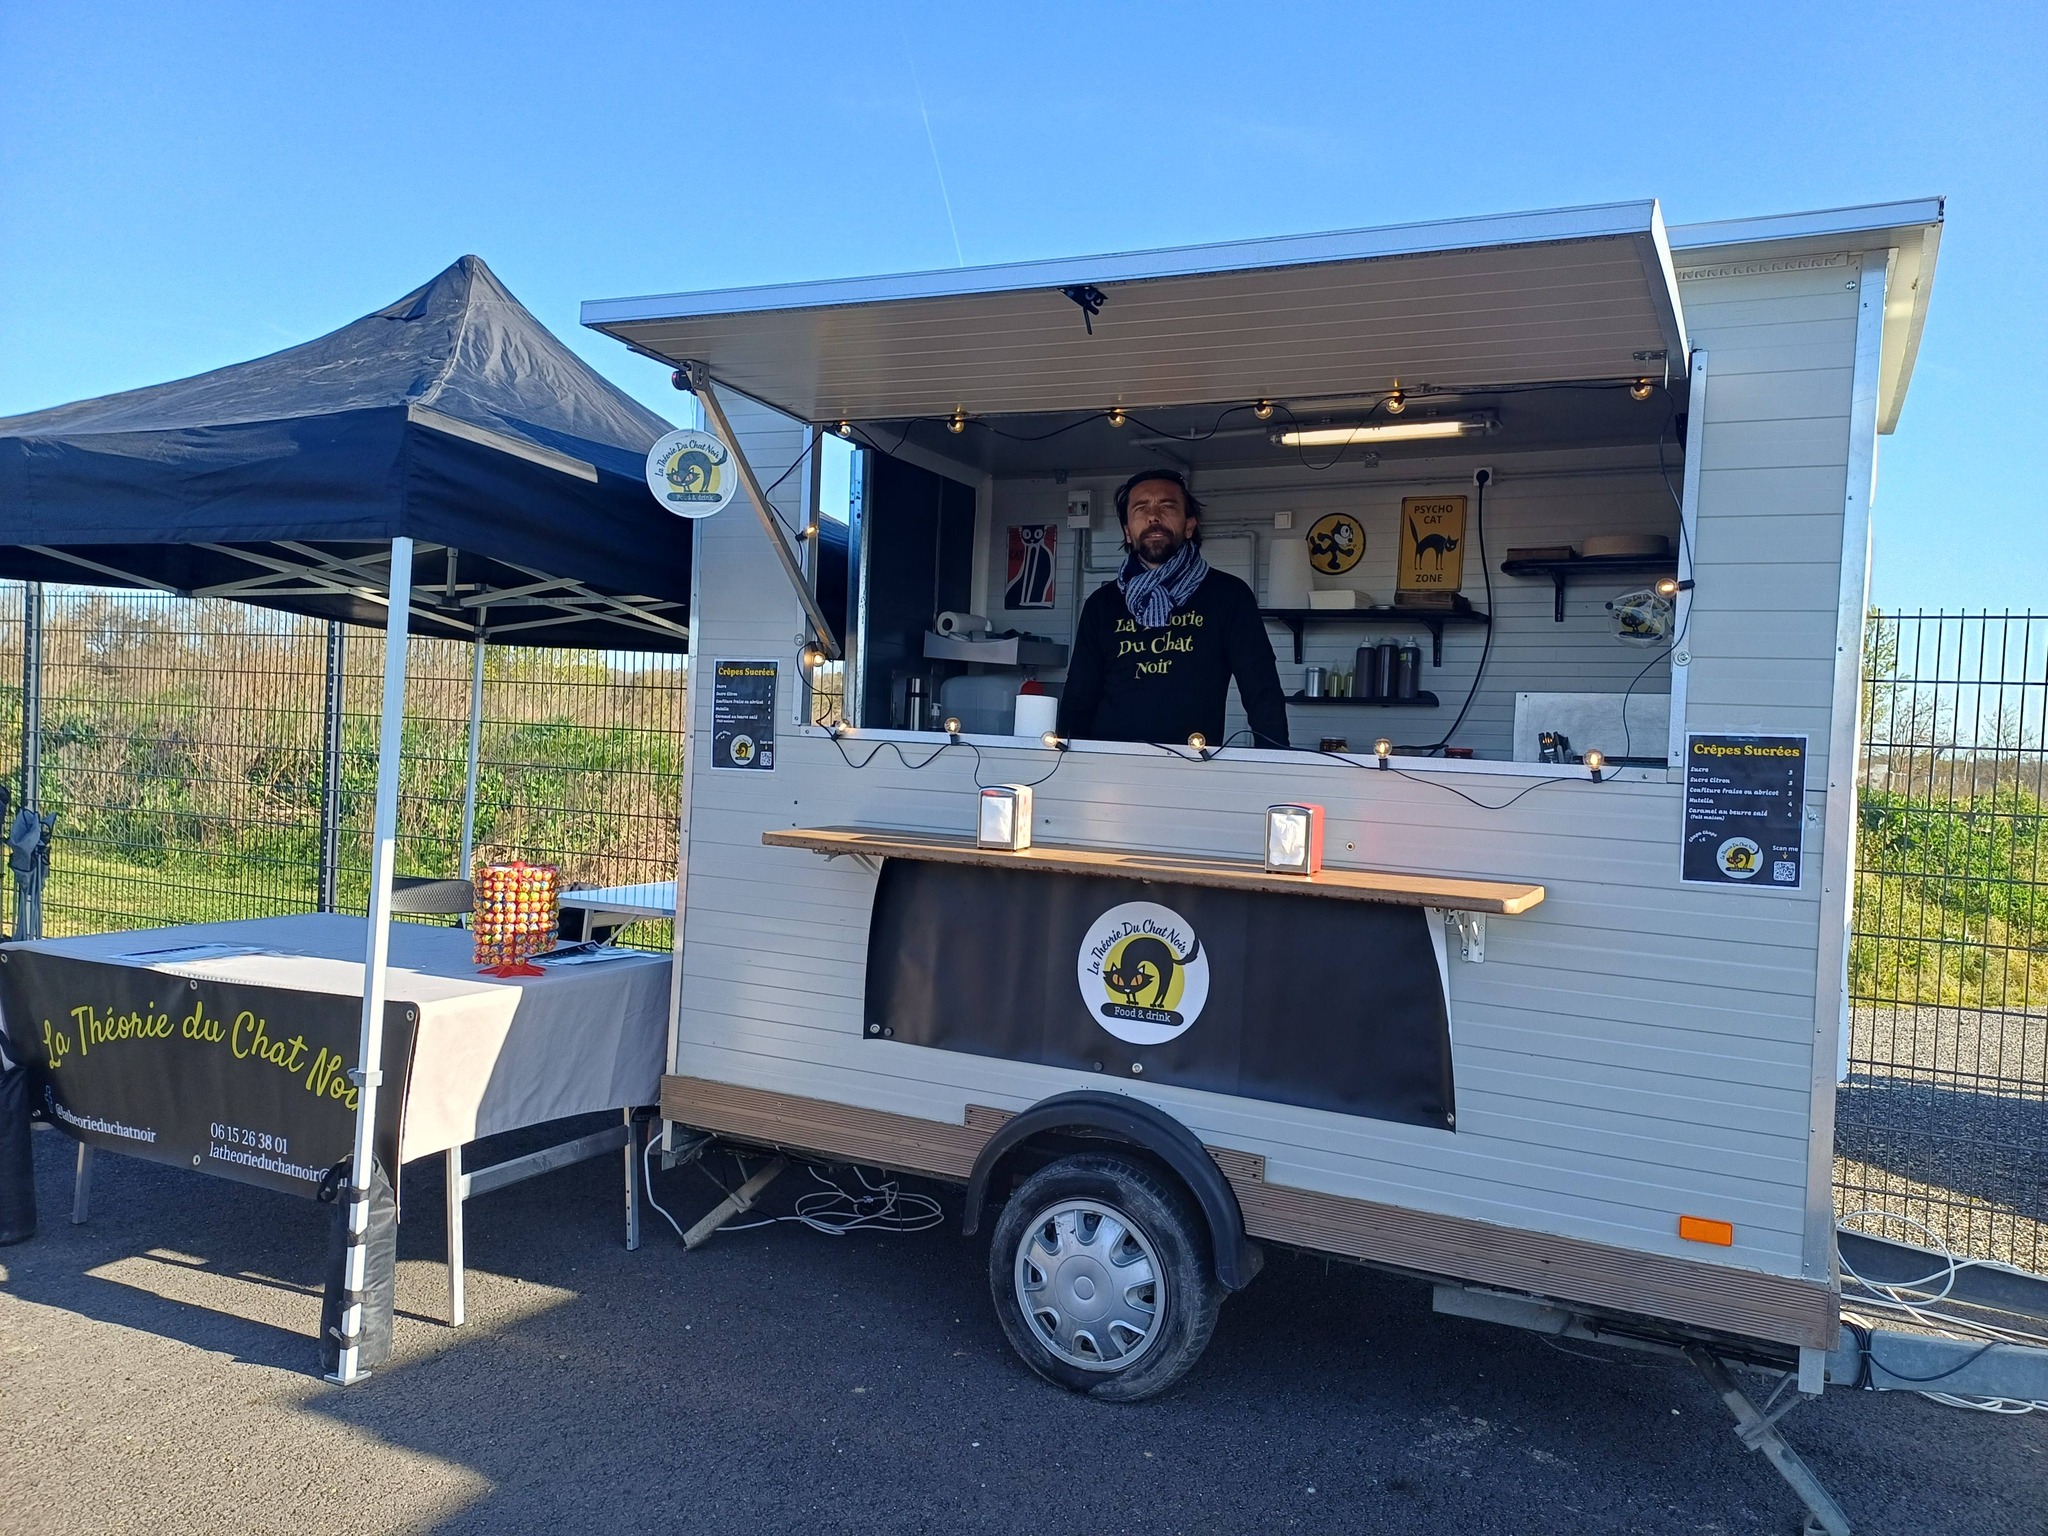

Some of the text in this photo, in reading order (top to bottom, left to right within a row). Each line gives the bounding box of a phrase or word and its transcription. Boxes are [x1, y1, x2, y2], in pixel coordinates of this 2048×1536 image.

[676, 442, 688, 451] Du
[689, 440, 704, 450] Chat
[706, 444, 720, 459] Noir
[1414, 504, 1453, 514] PSYCHO
[1424, 516, 1443, 524] CAT
[1416, 574, 1442, 583] ZONE
[1114, 610, 1204, 633] La orie
[1117, 631, 1194, 658] Du Chat
[1134, 658, 1172, 679] Noir
[1693, 744, 1800, 757] Crêpes Sucrées
[1087, 919, 1186, 975] La Théorie Du Chat Noir
[1114, 1006, 1170, 1022] Food & drink
[44, 1020, 71, 1069] La
[71, 1001, 174, 1056] Théorie
[182, 1001, 226, 1043] du
[231, 1011, 308, 1073] Chat
[210, 1122, 287, 1154] 06 15 26 38 01
